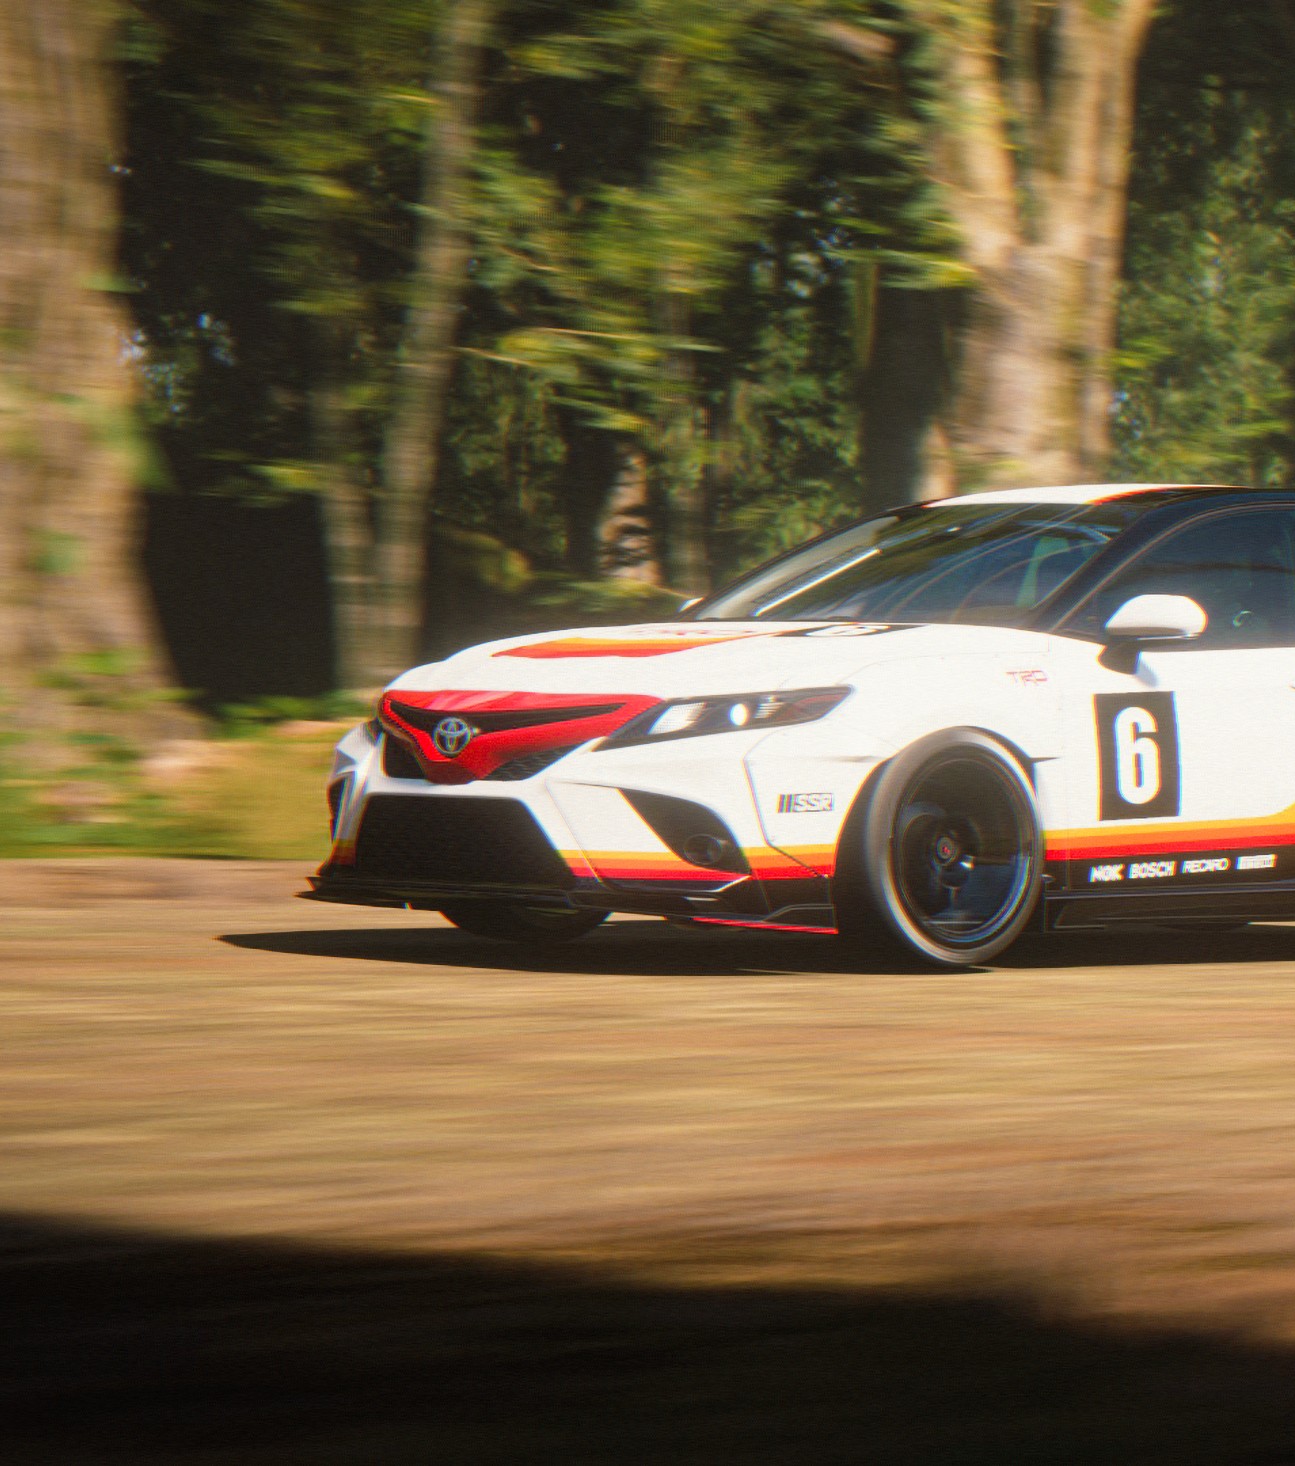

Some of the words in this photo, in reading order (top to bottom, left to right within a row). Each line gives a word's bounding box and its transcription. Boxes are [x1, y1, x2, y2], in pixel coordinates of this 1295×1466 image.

[1005, 669, 1048, 687] TRD
[1113, 706, 1162, 805] 6
[794, 793, 833, 812] SSR
[1128, 860, 1177, 879] BOSCH
